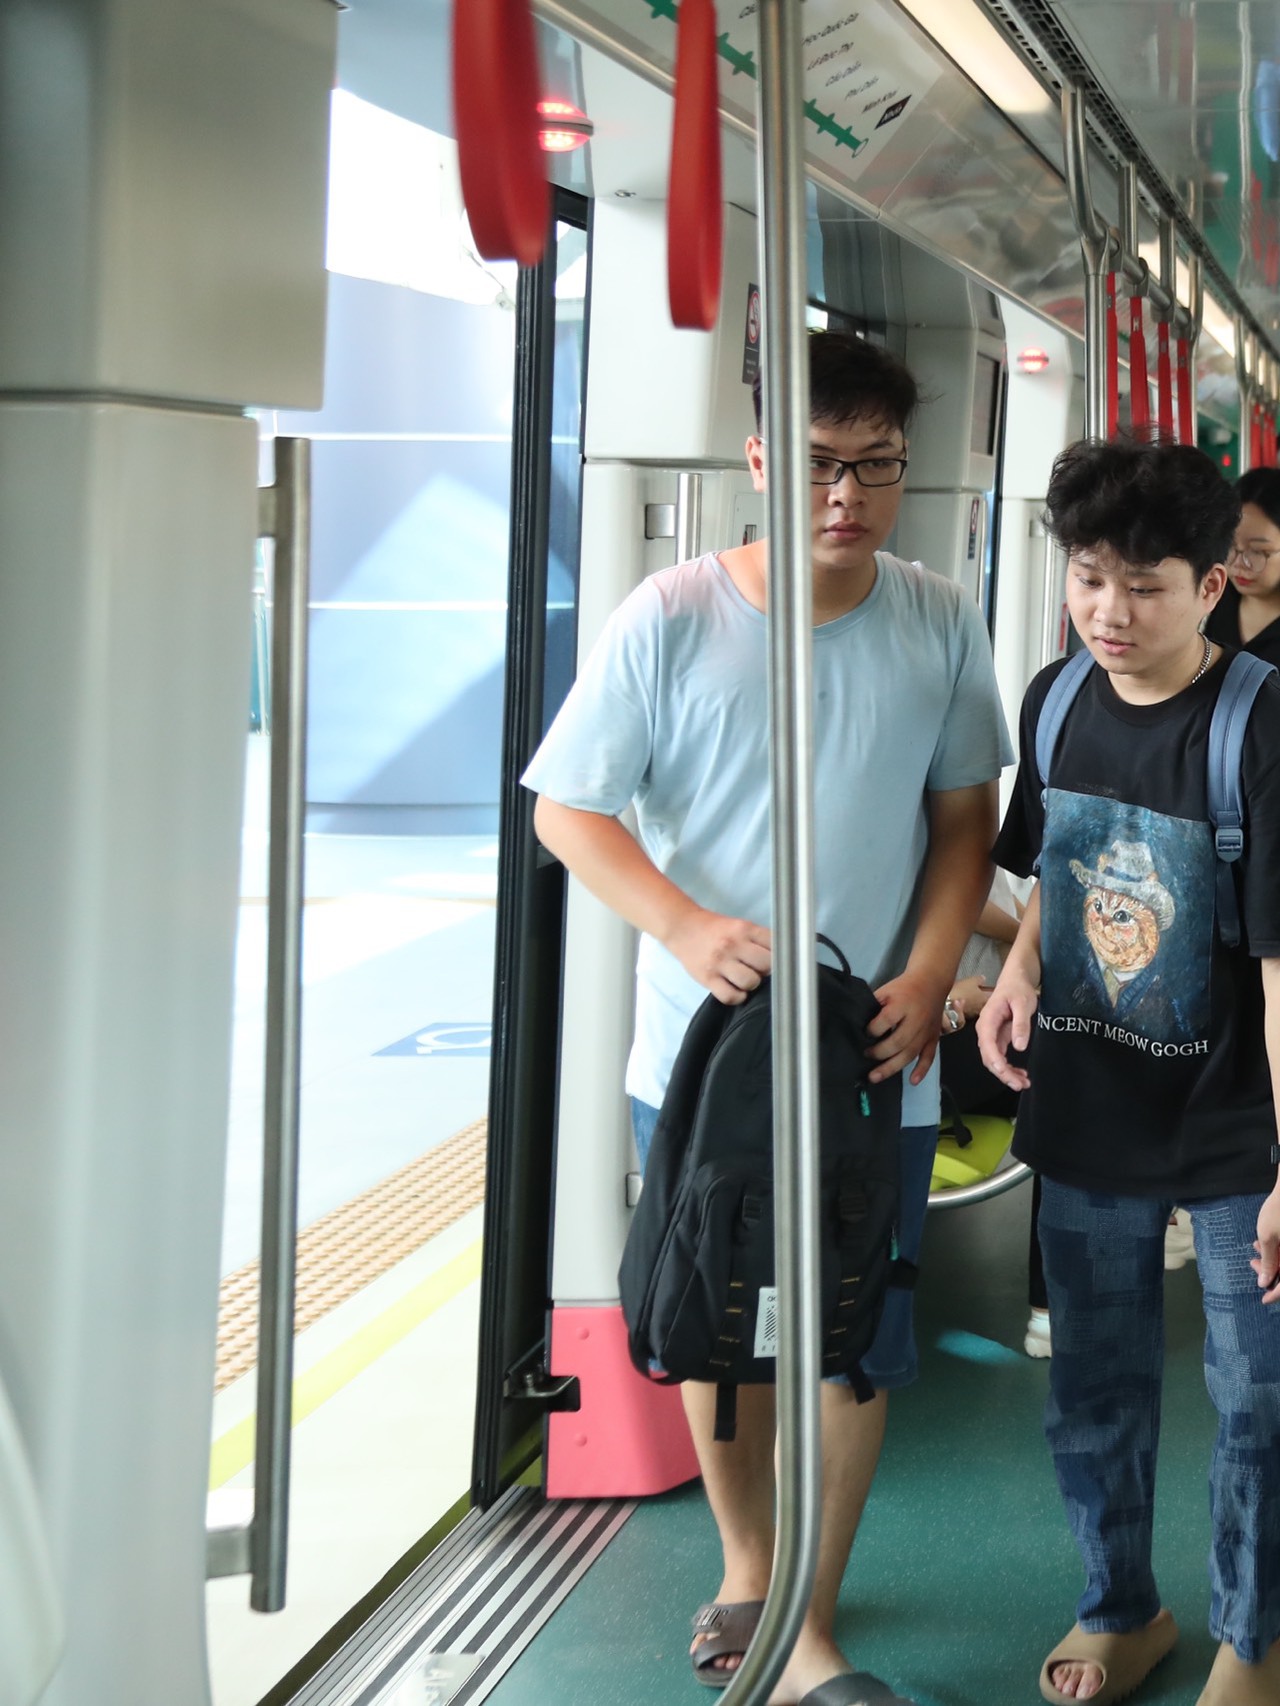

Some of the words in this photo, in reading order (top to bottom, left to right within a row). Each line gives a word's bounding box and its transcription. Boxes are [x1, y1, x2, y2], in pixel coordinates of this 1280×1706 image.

[1037, 1012, 1101, 1036] INCENT
[1104, 1024, 1149, 1051] MEOW
[1150, 1040, 1209, 1057] GOGH
